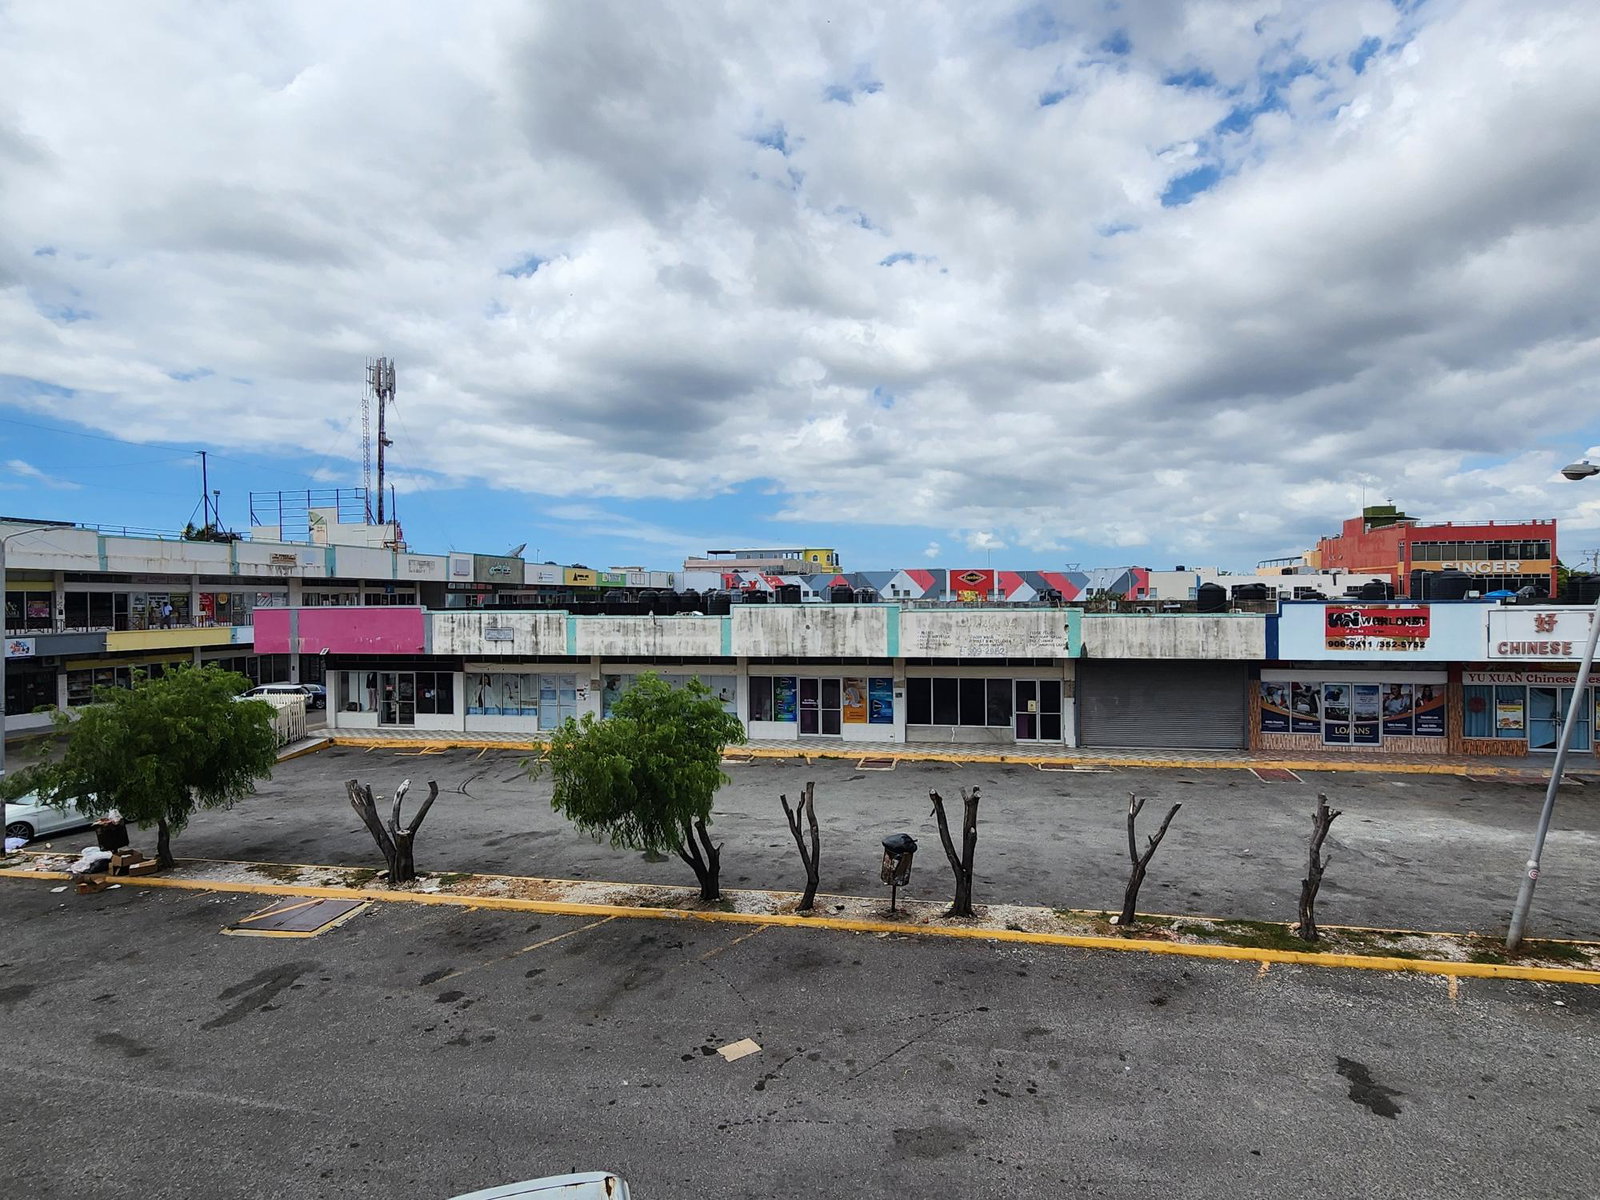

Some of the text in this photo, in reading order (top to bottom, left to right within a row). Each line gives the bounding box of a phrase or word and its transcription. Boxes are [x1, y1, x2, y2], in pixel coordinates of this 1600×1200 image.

[1442, 561, 1520, 574] SINGER
[1534, 613, 1558, 633] 好
[1498, 641, 1573, 655] CHINESE
[1468, 673, 1486, 683] YU
[1489, 673, 1522, 683] XUAN
[1526, 674, 1577, 684] Chinese
